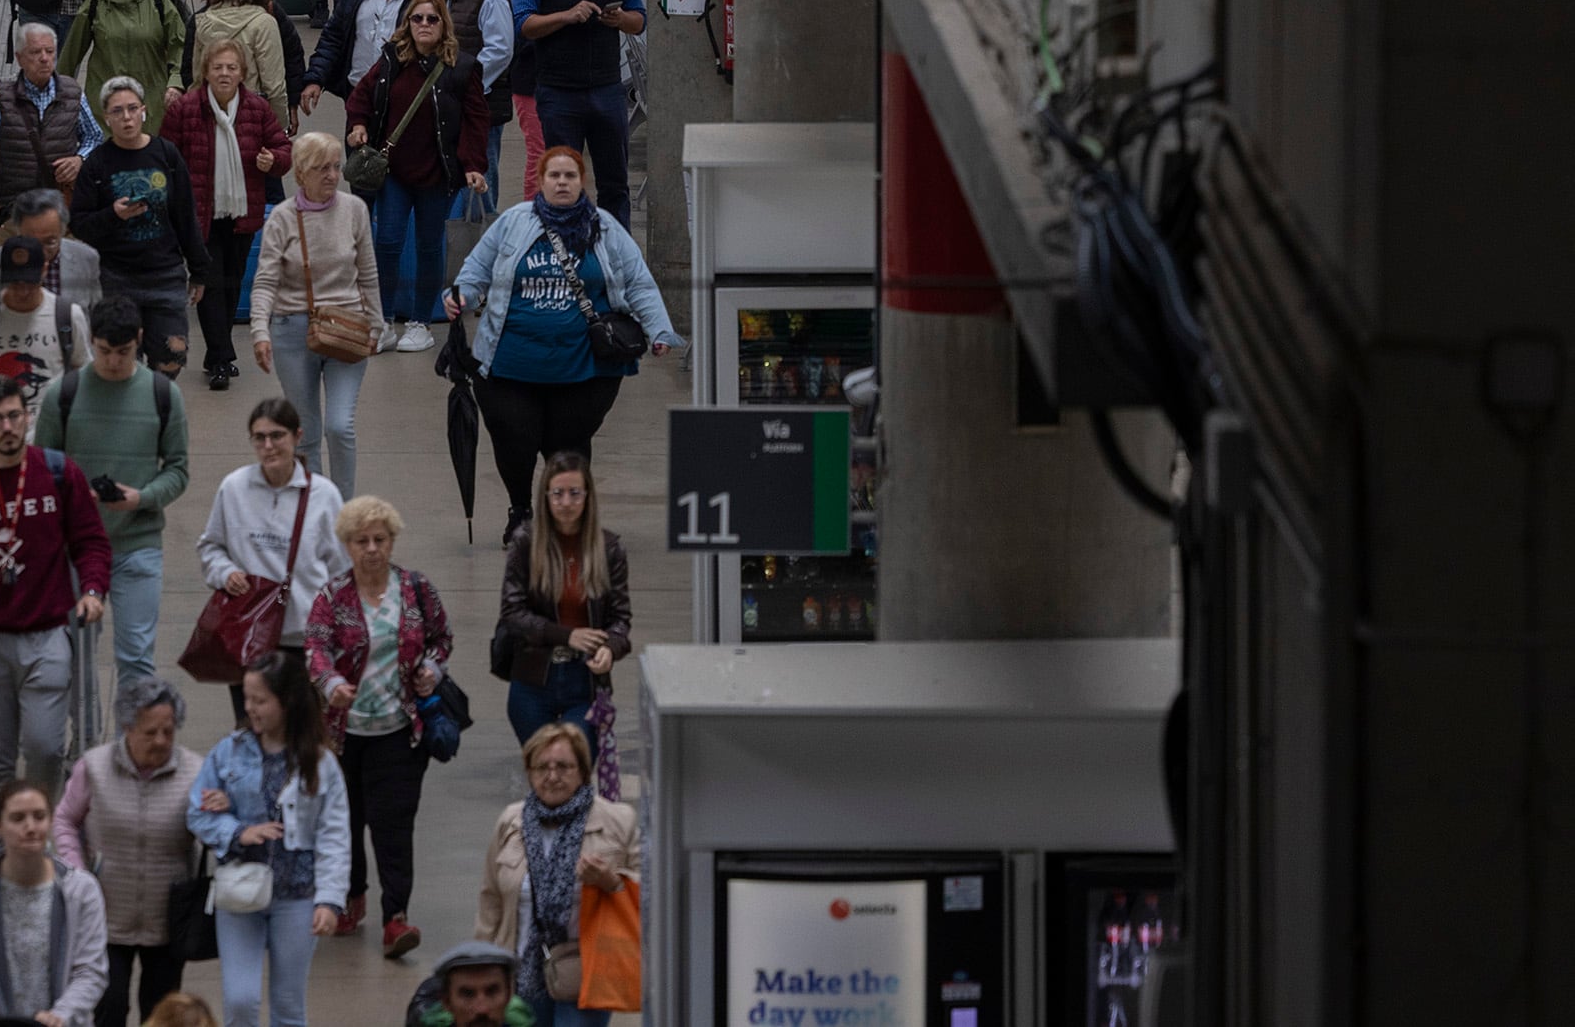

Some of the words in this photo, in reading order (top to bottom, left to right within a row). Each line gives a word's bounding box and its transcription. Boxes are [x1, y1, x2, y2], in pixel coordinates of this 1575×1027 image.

[527, 253, 548, 271] ALL
[762, 419, 791, 439] Vía
[677, 491, 740, 544] 11
[753, 968, 843, 995] Make
[849, 967, 900, 995] the
[748, 1000, 806, 1027] day
